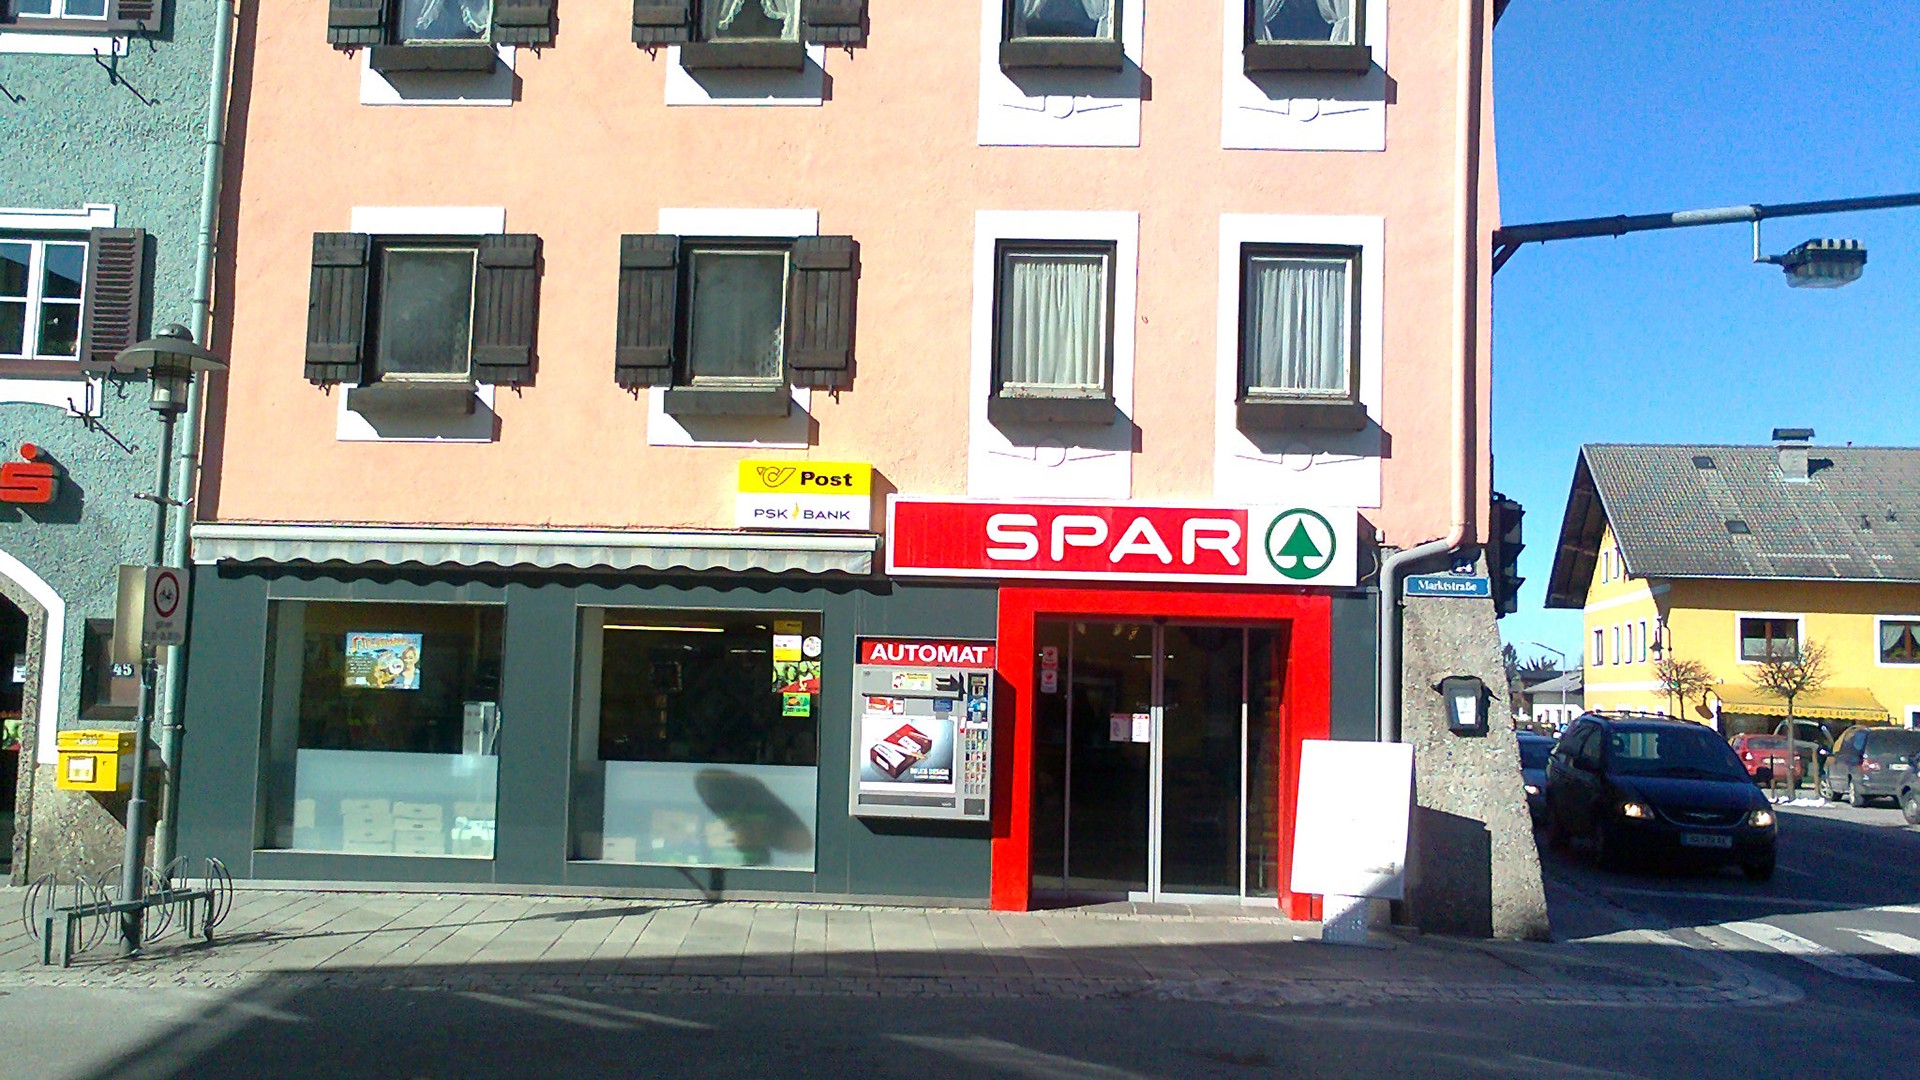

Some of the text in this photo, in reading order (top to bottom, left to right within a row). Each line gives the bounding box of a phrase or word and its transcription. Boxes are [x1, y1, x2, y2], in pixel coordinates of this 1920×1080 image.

[801, 471, 853, 487] Post
[754, 508, 850, 520] PSK BANK
[986, 512, 1241, 567] SPAR
[1418, 580, 1477, 591] Marktstraße
[871, 643, 988, 664] AUTOMAT
[113, 663, 133, 676] 45
